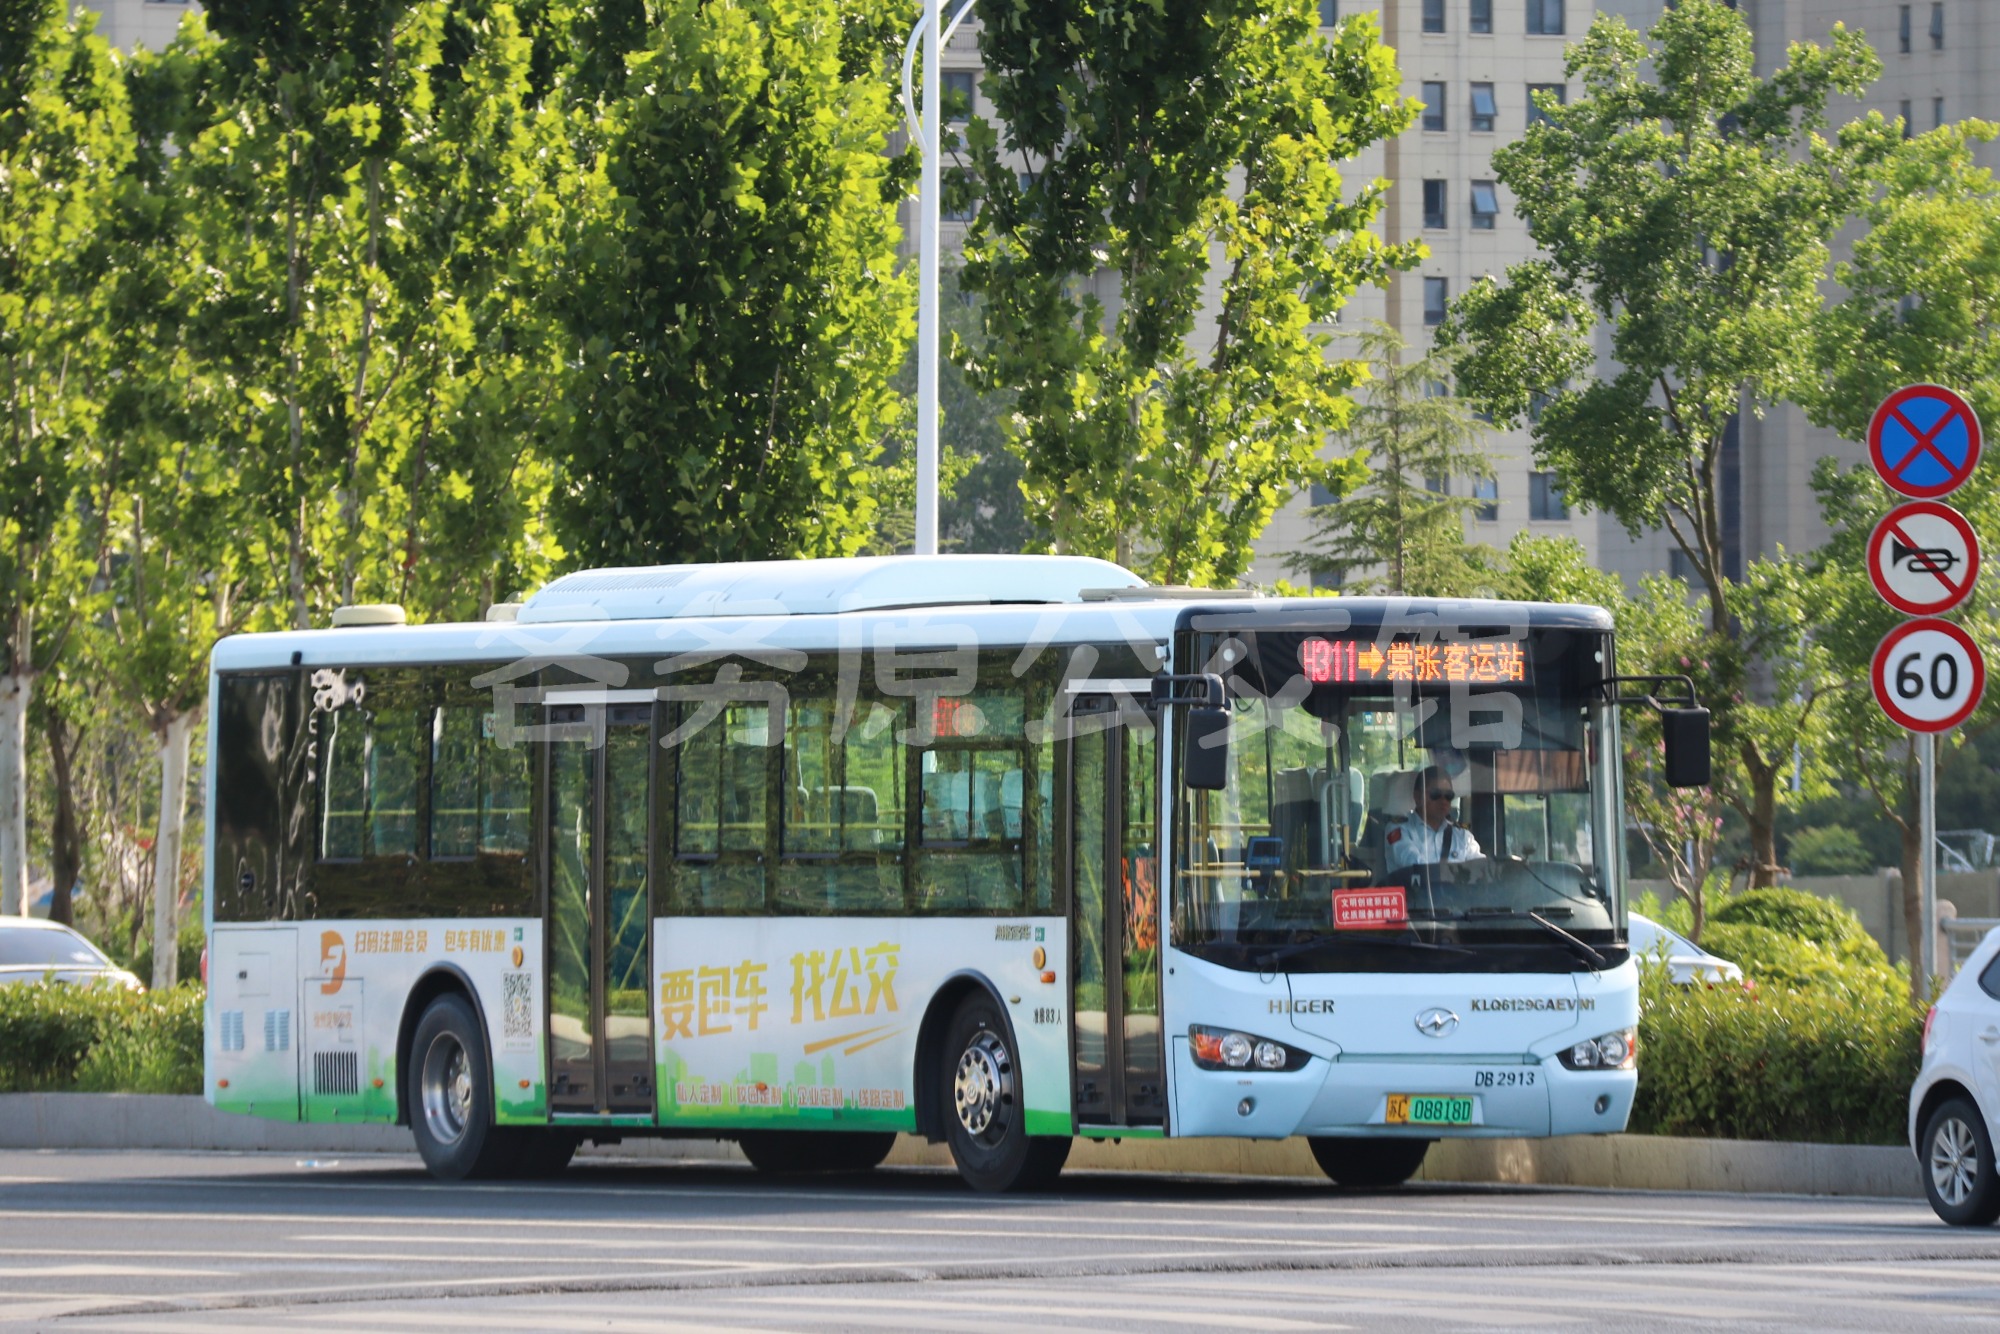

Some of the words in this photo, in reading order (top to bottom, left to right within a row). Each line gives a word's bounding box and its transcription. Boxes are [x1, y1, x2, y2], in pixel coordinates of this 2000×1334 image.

[1303, 640, 1356, 682] H311
[1387, 642, 1524, 681] 棠张客运站
[1896, 652, 1958, 700] 60
[354, 929, 428, 953] 扫码注册会员
[444, 929, 506, 952] 包车有优惠
[660, 959, 768, 1040] 要包车
[790, 942, 900, 1024] 找公交
[1269, 999, 1334, 1014] HIGER
[676, 1084, 722, 1104] 私人定制
[797, 1086, 844, 1107] 企业定制
[859, 1088, 905, 1110] 线路定制
